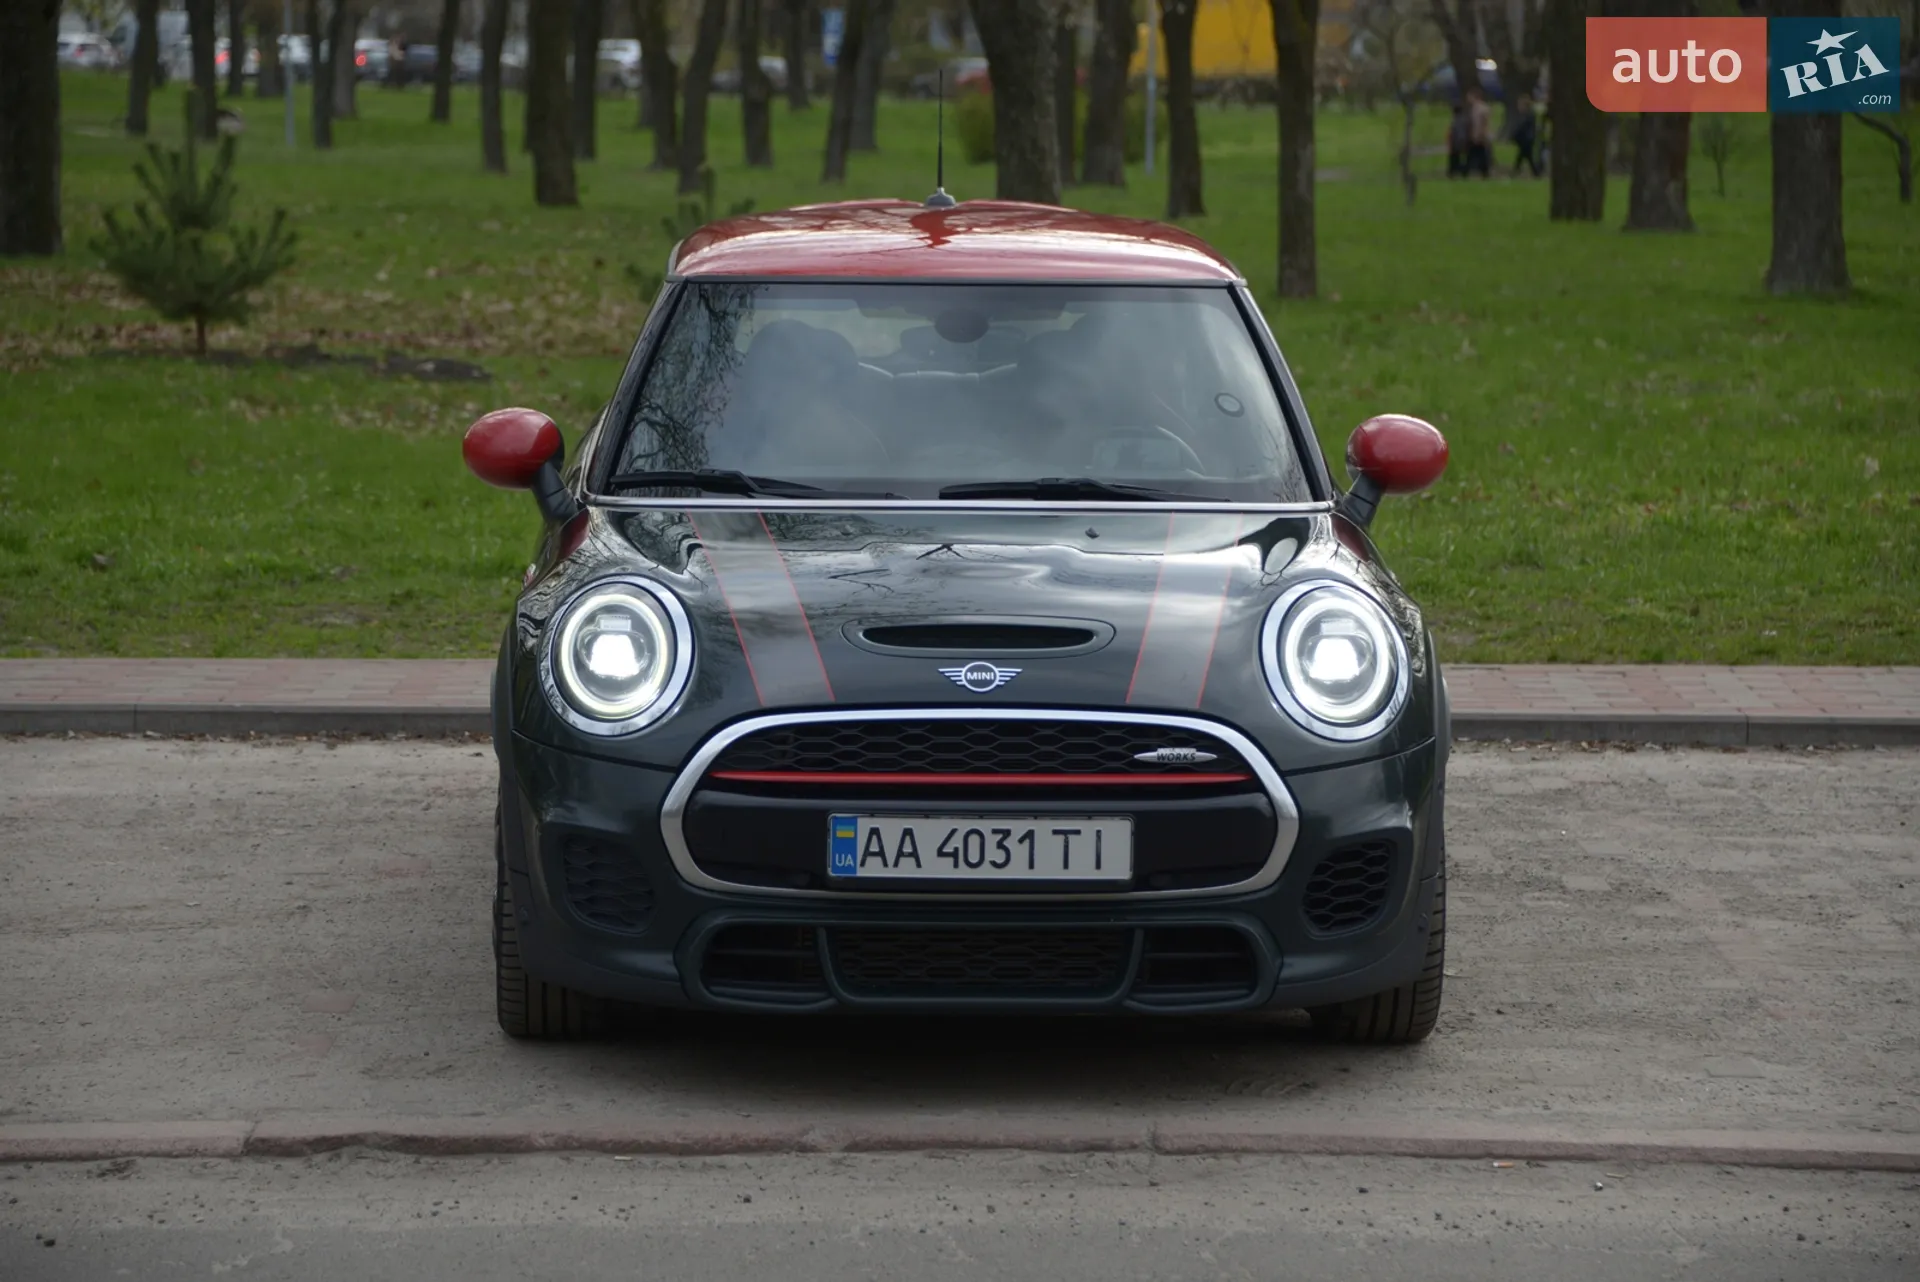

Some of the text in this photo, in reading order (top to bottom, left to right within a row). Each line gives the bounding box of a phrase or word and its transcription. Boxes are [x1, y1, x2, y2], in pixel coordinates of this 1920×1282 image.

[966, 671, 995, 680] MINI
[1156, 752, 1196, 762] WORKS
[859, 826, 923, 869] AA
[935, 827, 1036, 871] 4031
[835, 853, 854, 867] UA
